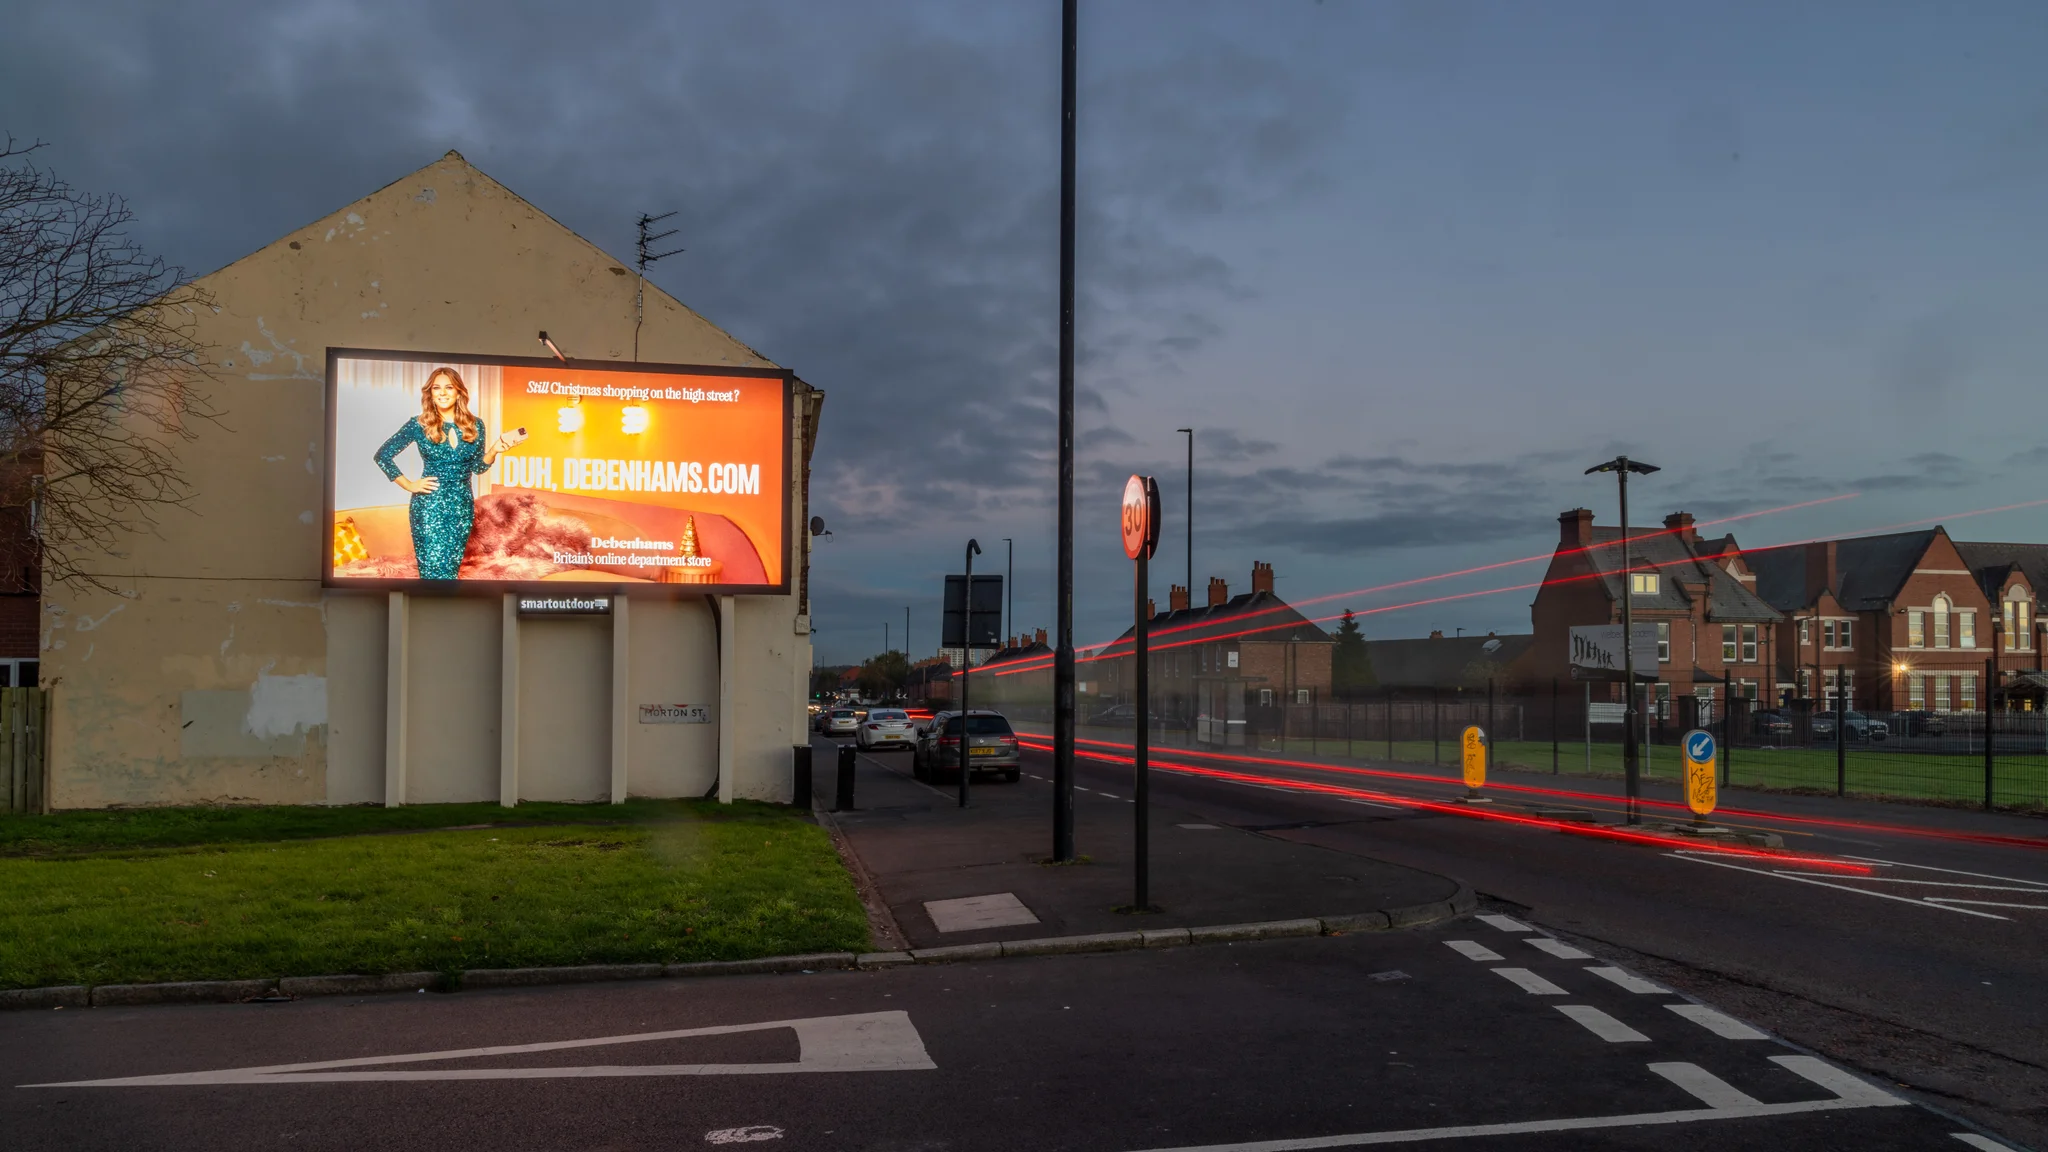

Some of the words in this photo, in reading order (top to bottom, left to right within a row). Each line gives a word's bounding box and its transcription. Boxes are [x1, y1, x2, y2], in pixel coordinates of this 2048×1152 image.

[526, 380, 549, 394] Still
[550, 381, 602, 396] Christmas
[602, 384, 650, 401] shopping
[650, 388, 664, 399] on
[665, 387, 682, 400] the
[682, 387, 706, 404] high
[503, 455, 558, 493] DUH,
[563, 457, 760, 495] DEBENHAMS.COM
[1125, 498, 1142, 537] 30
[591, 536, 674, 550] Debenhams
[553, 551, 594, 565] Britain's
[594, 552, 627, 565] online
[628, 553, 687, 568] department
[687, 556, 712, 567] store
[520, 597, 595, 609] smartoutdoor
[644, 708, 688, 717] MORTON
